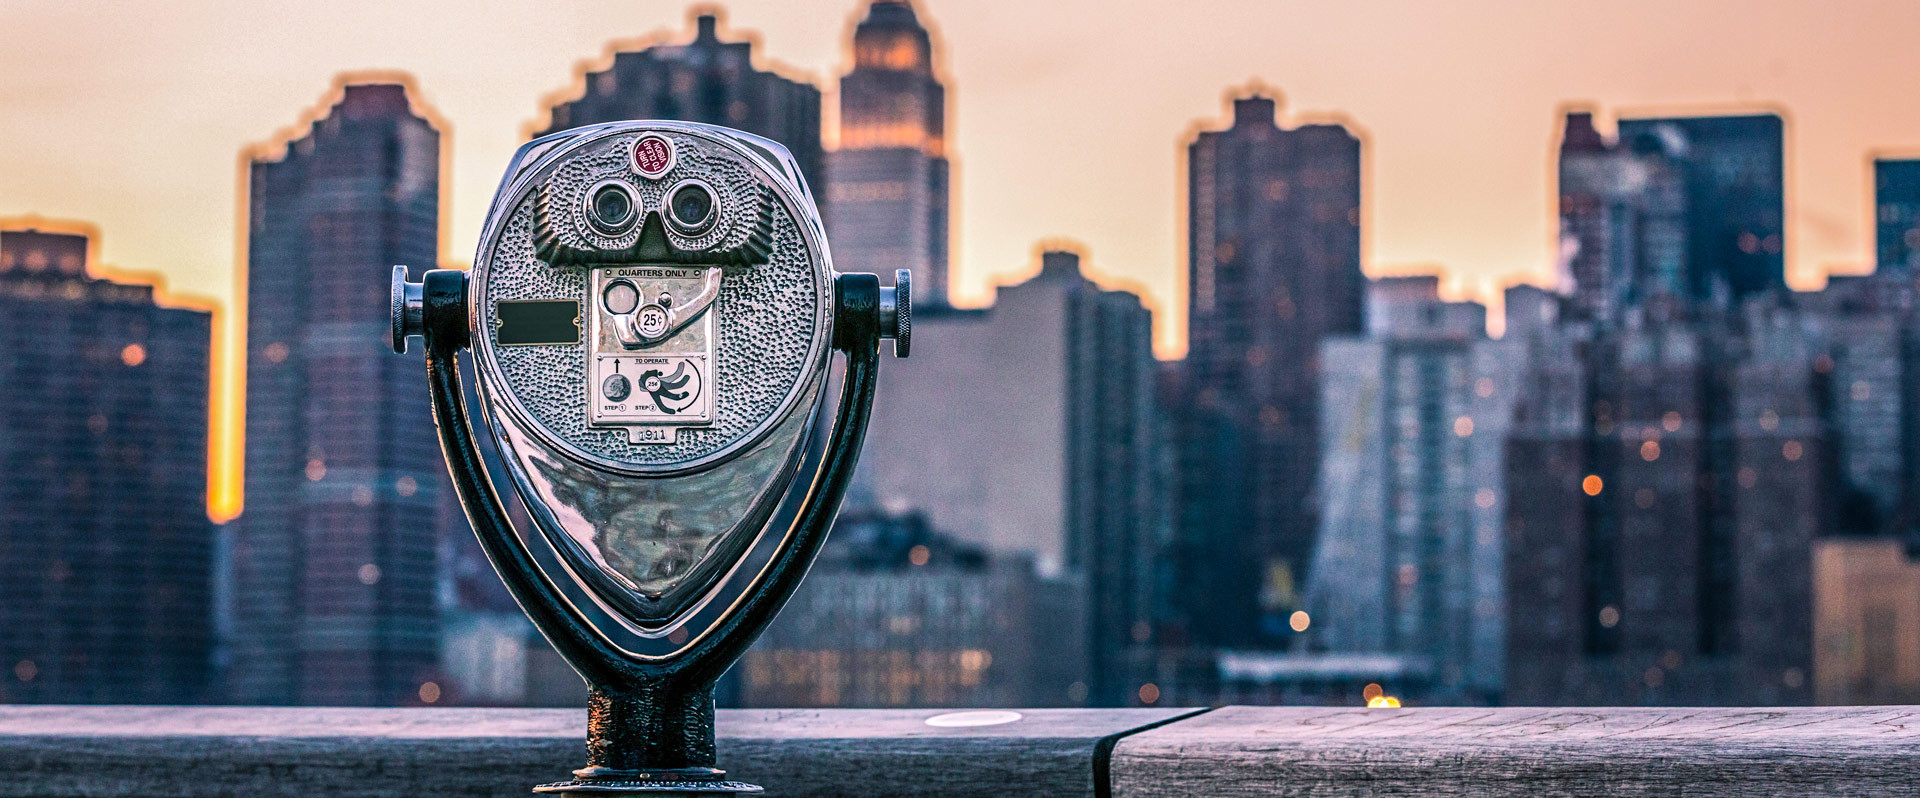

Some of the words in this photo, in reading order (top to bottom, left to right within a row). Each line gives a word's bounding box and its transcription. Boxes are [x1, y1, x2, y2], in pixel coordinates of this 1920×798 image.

[643, 141, 657, 162] CLEAR
[653, 142, 667, 163] VISION
[638, 151, 650, 168] TURN
[652, 162, 661, 171] TO
[618, 269, 663, 277] QUARTERS
[665, 269, 688, 277] ONLY
[643, 313, 662, 326] 25¢
[638, 429, 666, 442] 1911
